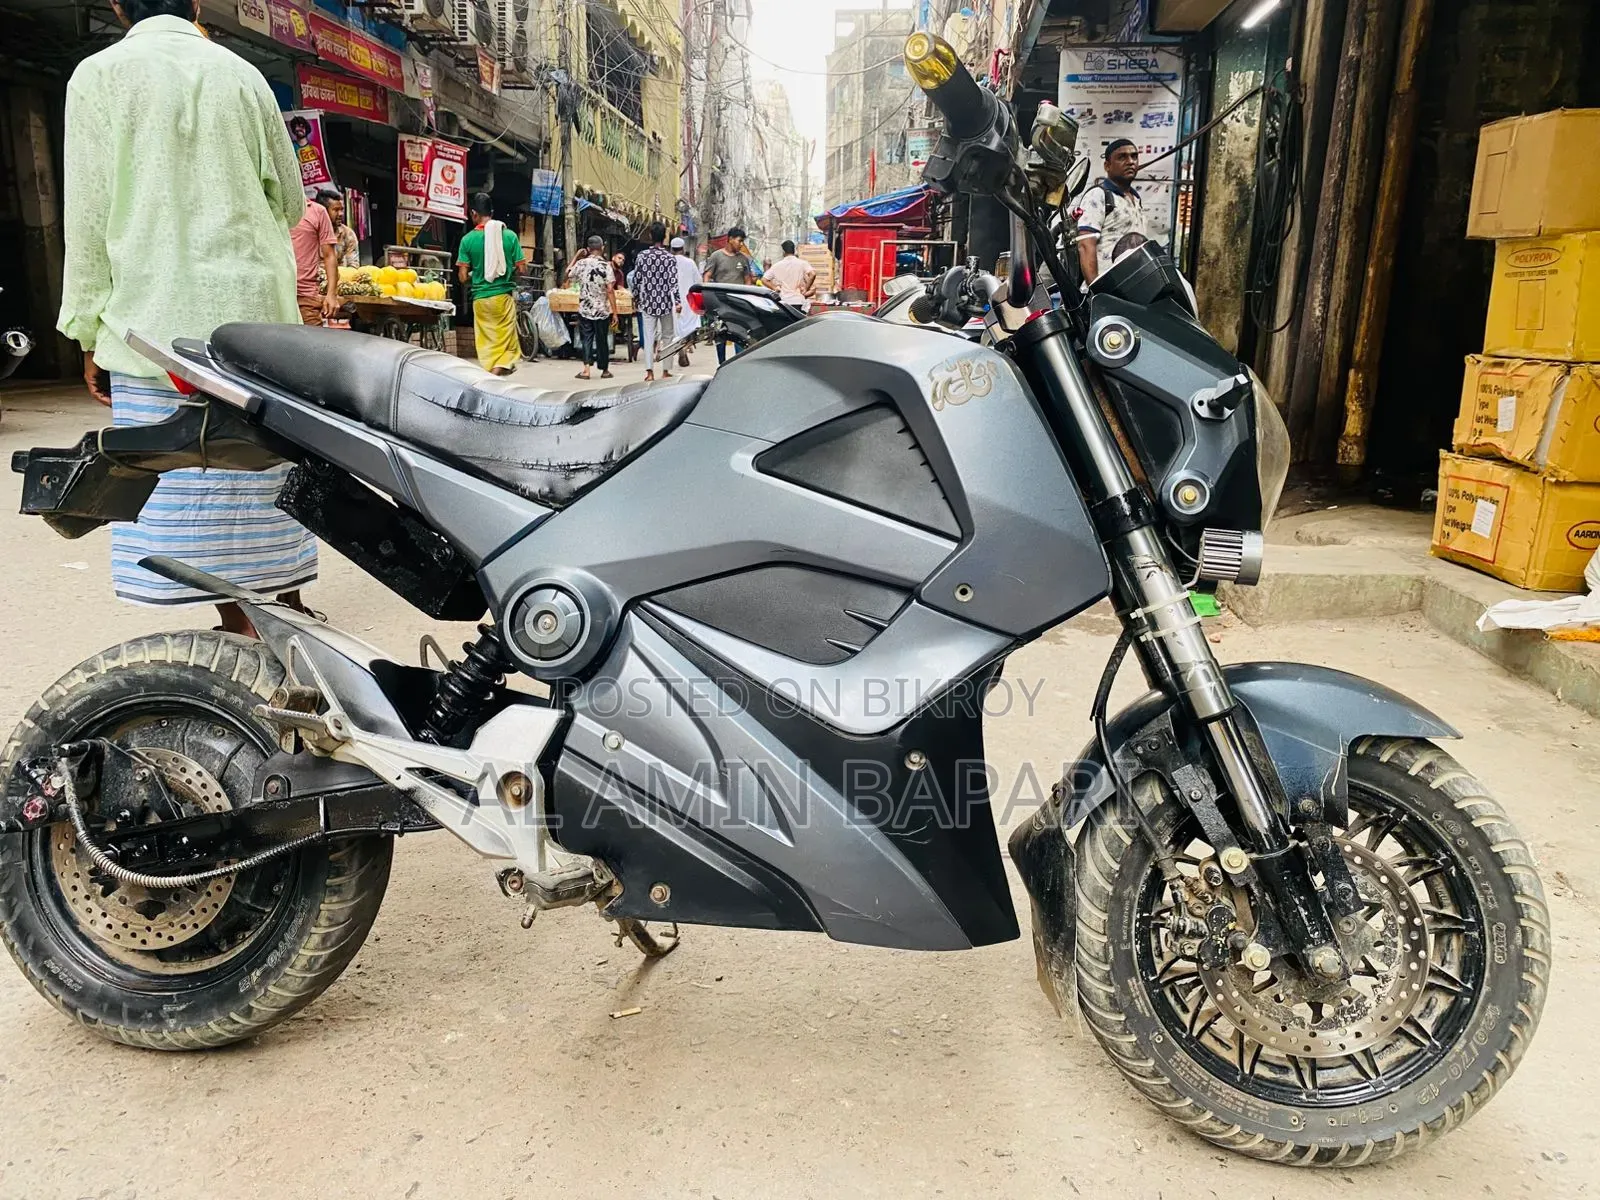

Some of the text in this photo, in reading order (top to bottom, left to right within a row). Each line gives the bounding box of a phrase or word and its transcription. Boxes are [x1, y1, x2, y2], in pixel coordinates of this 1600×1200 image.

[1107, 49, 1149, 57] FACTORY
[1107, 59, 1160, 70] SHEBA
[434, 183, 461, 199] নগদ
[1514, 253, 1552, 264] POLYRON
[1416, 1002, 1502, 1106] 120/70-12
